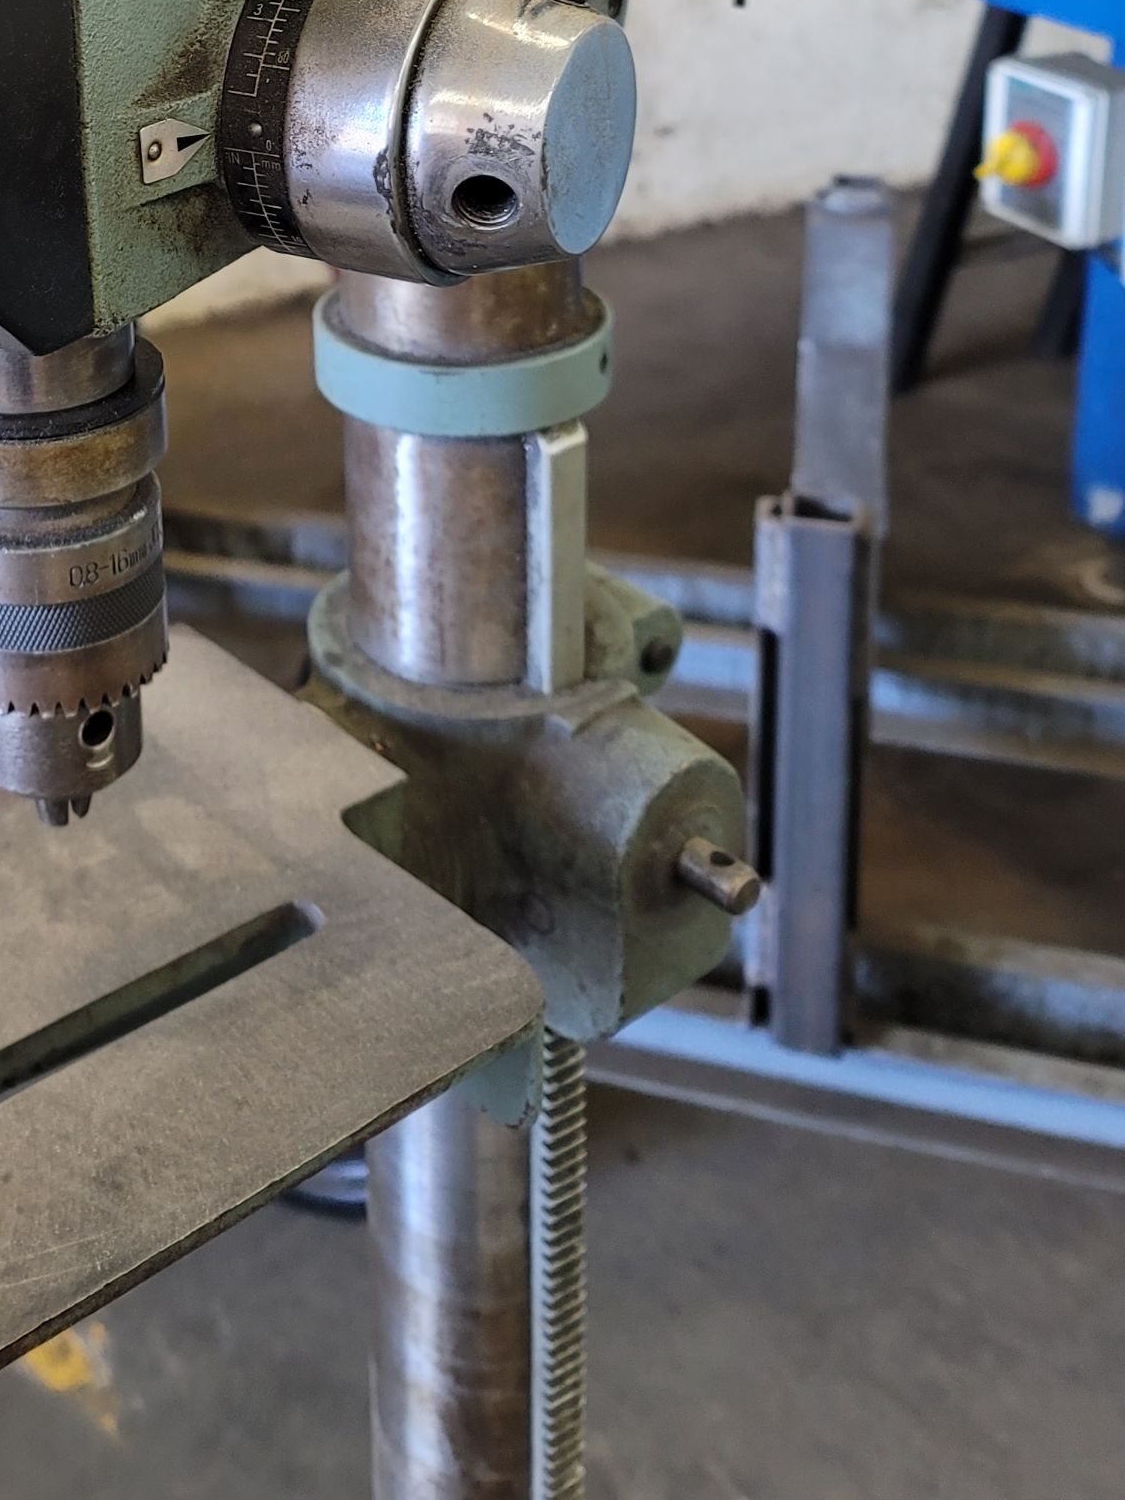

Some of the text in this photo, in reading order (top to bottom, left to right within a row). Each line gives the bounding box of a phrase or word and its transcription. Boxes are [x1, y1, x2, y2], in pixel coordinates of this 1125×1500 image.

[253, 3, 264, 15] 3
[265, 139, 272, 152] 0
[261, 159, 281, 172] mm
